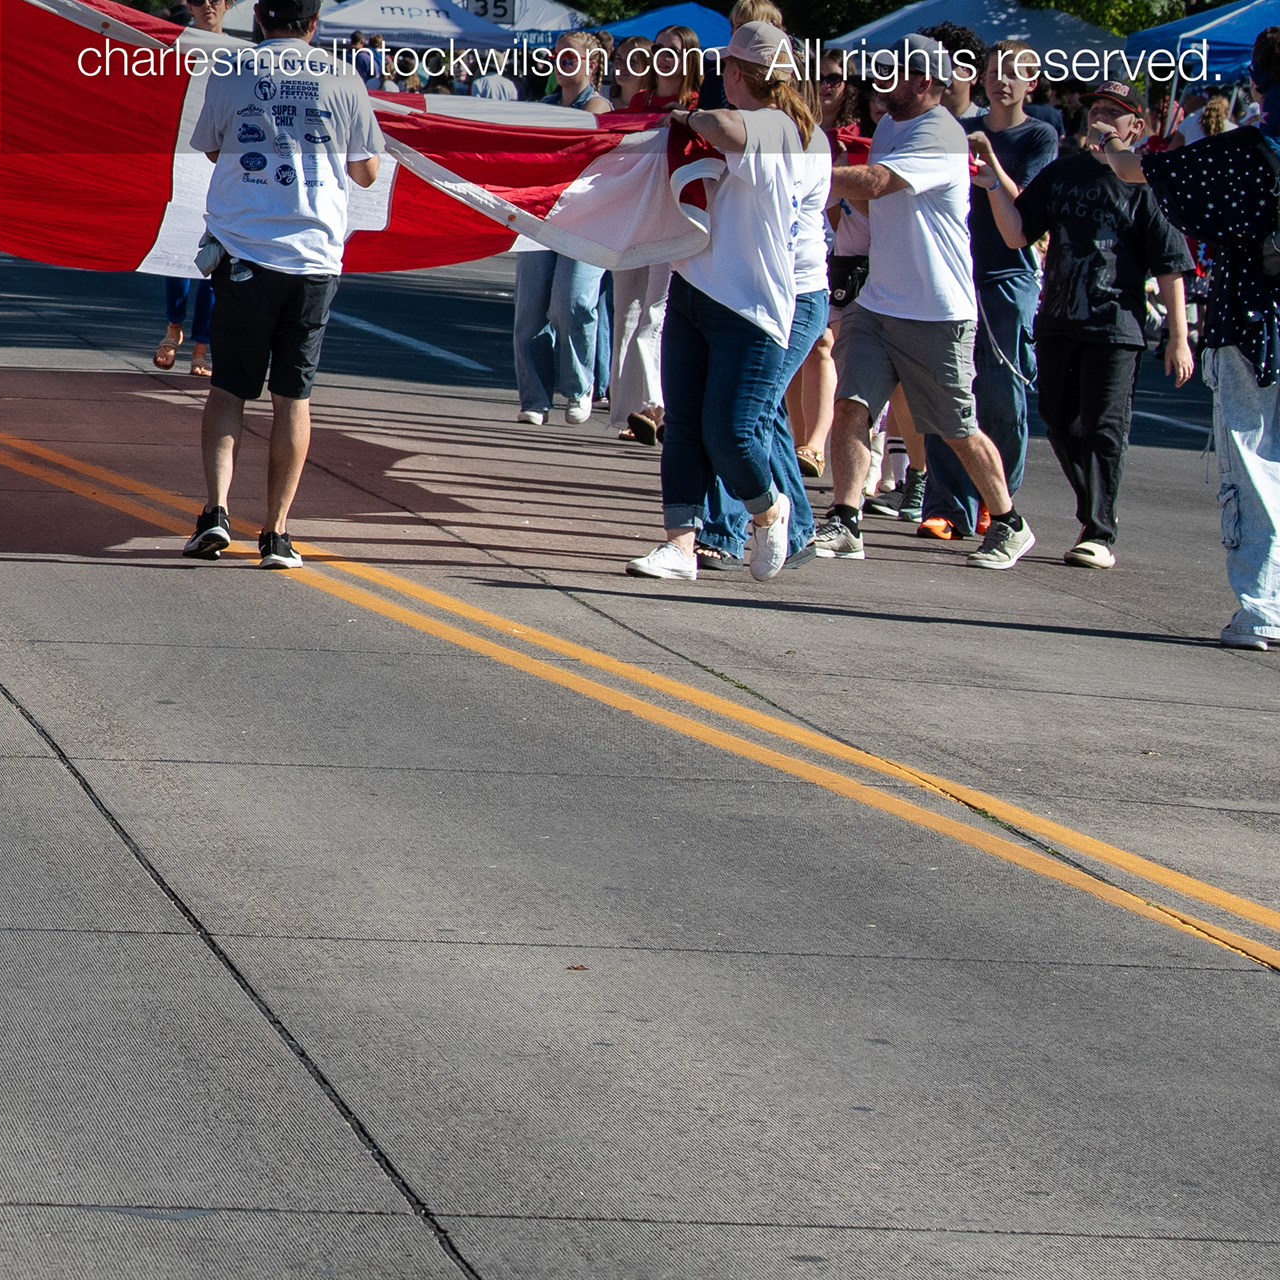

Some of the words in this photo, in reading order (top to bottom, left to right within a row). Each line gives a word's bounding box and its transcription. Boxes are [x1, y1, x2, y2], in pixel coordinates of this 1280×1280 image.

[380, 5, 450, 19] mpm
[271, 105, 297, 116] SUPER
[274, 116, 294, 127] CHIX
